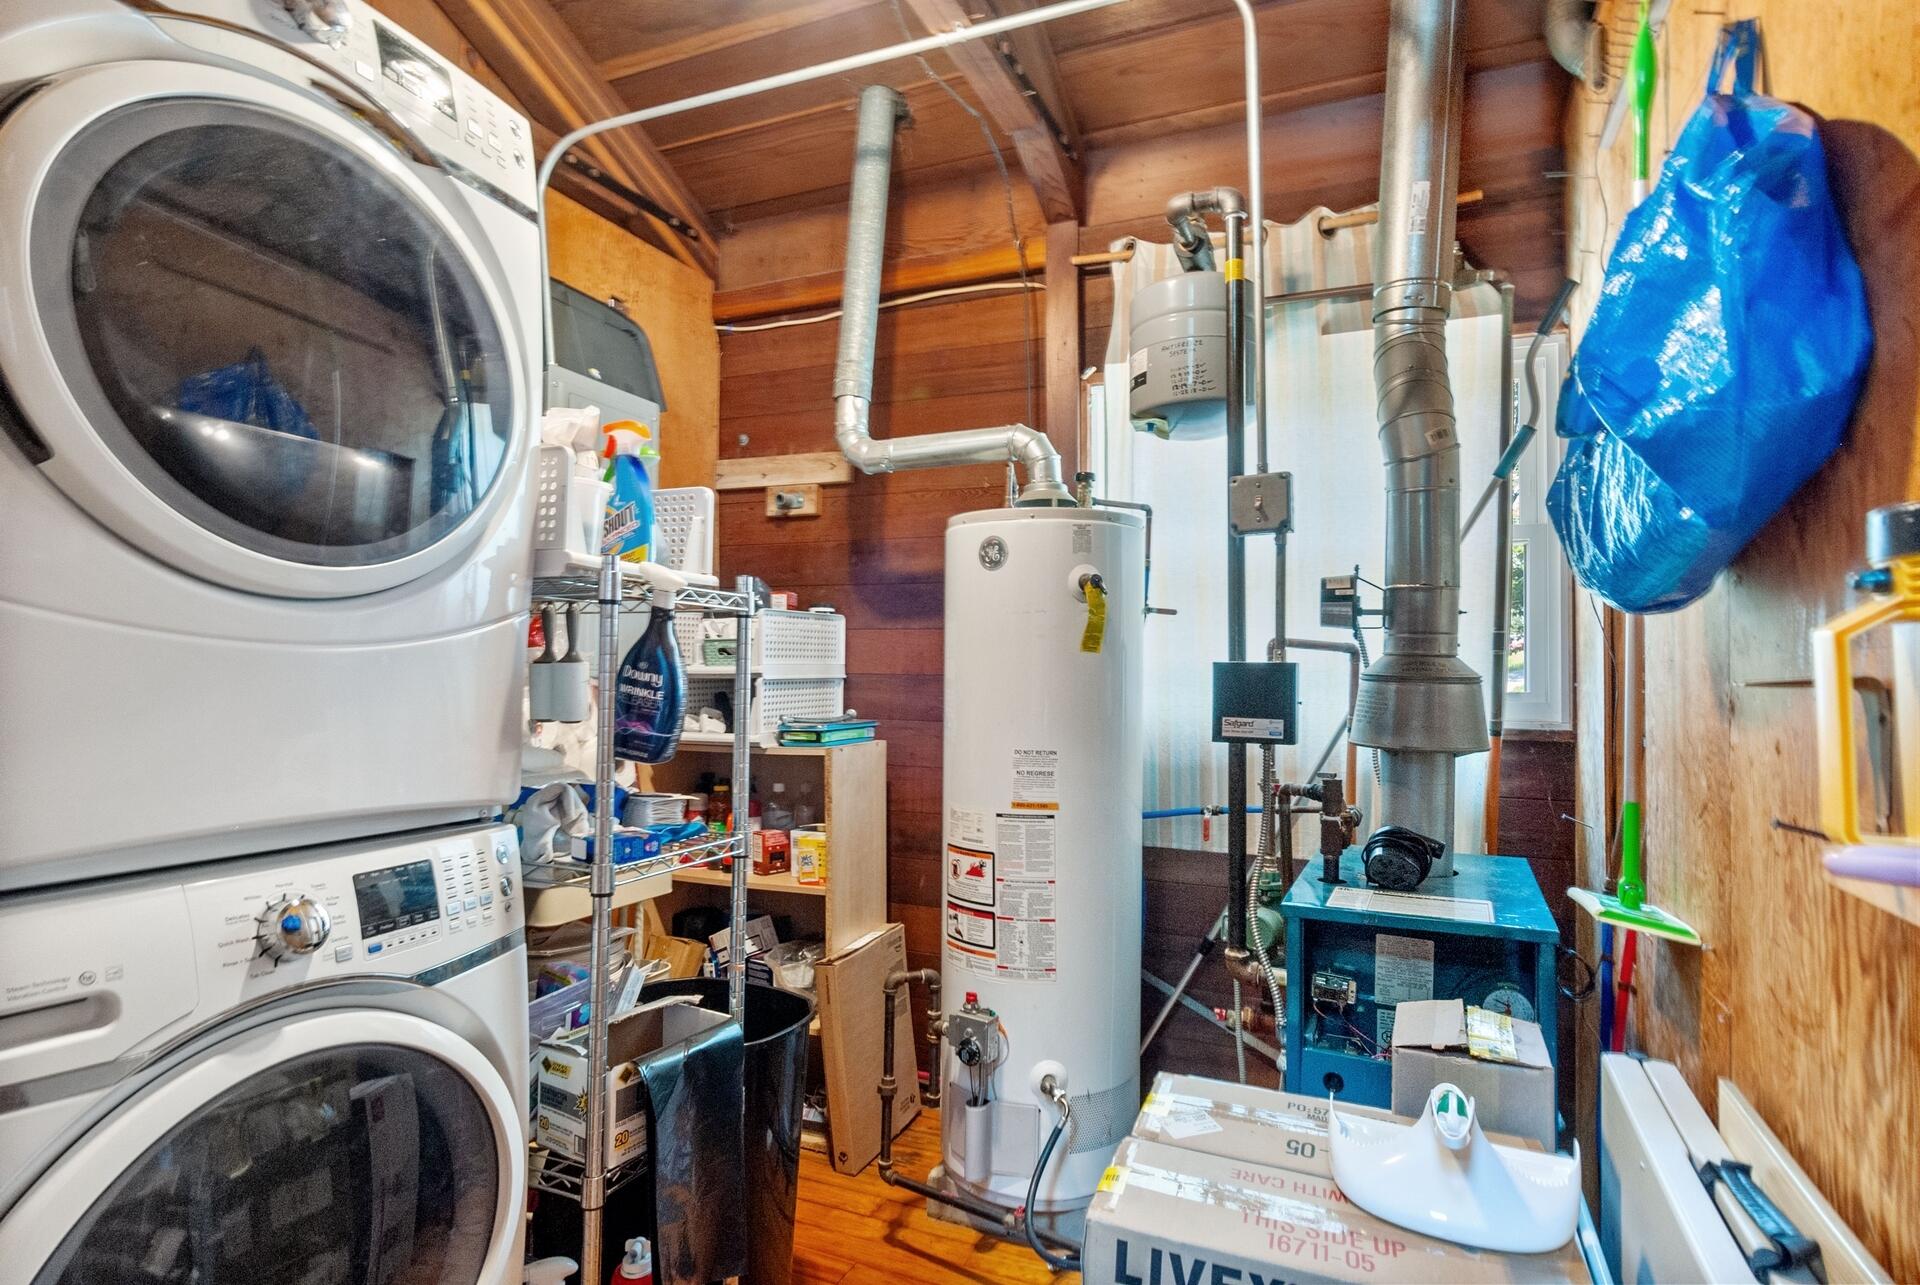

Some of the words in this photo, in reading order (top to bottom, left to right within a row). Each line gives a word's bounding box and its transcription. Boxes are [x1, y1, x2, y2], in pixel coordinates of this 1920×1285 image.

[604, 502, 635, 538] SHOUT
[622, 664, 664, 688] Downy
[619, 683, 665, 700] WRINKLE
[540, 1114, 550, 1131] 20
[614, 1129, 630, 1149] 20
[1231, 1168, 1285, 1190] CARE
[1293, 1180, 1349, 1205] WITH
[1266, 1232, 1376, 1273] 16711-05
[1304, 1225, 1365, 1251] SIDE
[1373, 1235, 1407, 1258] UP
[1114, 1237, 1287, 1285] LIVE
